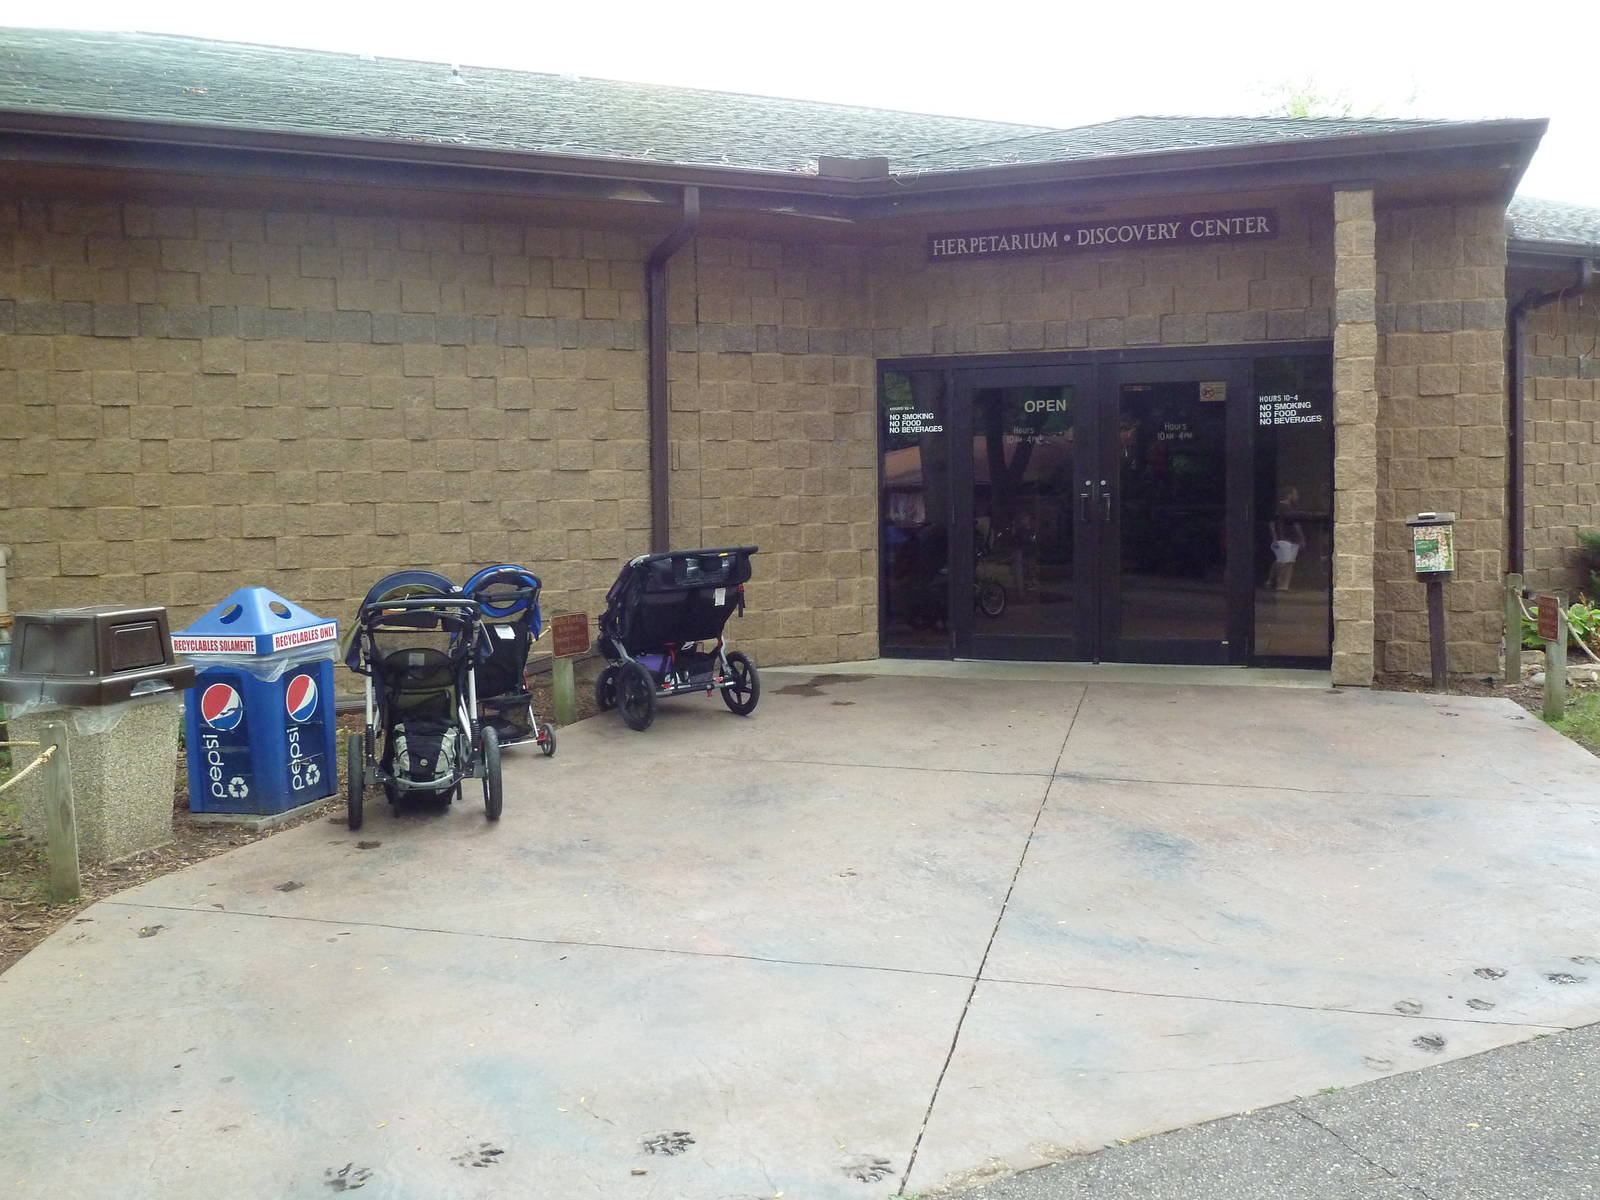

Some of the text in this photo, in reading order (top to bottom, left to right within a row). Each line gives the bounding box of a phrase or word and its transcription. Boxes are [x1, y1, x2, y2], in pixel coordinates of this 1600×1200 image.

[933, 216, 1270, 255] HERPETARIUM DISCOVERY CENTER
[1259, 394, 1299, 403] HOURS 10-4
[1024, 399, 1066, 413] OPEN
[1274, 402, 1312, 410] SMOKING
[901, 412, 934, 420] SMOKING
[1274, 410, 1297, 418] FOOD
[1274, 415, 1322, 424] BEVERAGES
[901, 425, 943, 433] BEVERAGES
[275, 625, 335, 649] RECYCLABLES ONLY
[173, 639, 254, 652] RECYCLABLES SOLAMENTE
[286, 726, 305, 791] pepsi
[202, 734, 228, 798] pepsi
